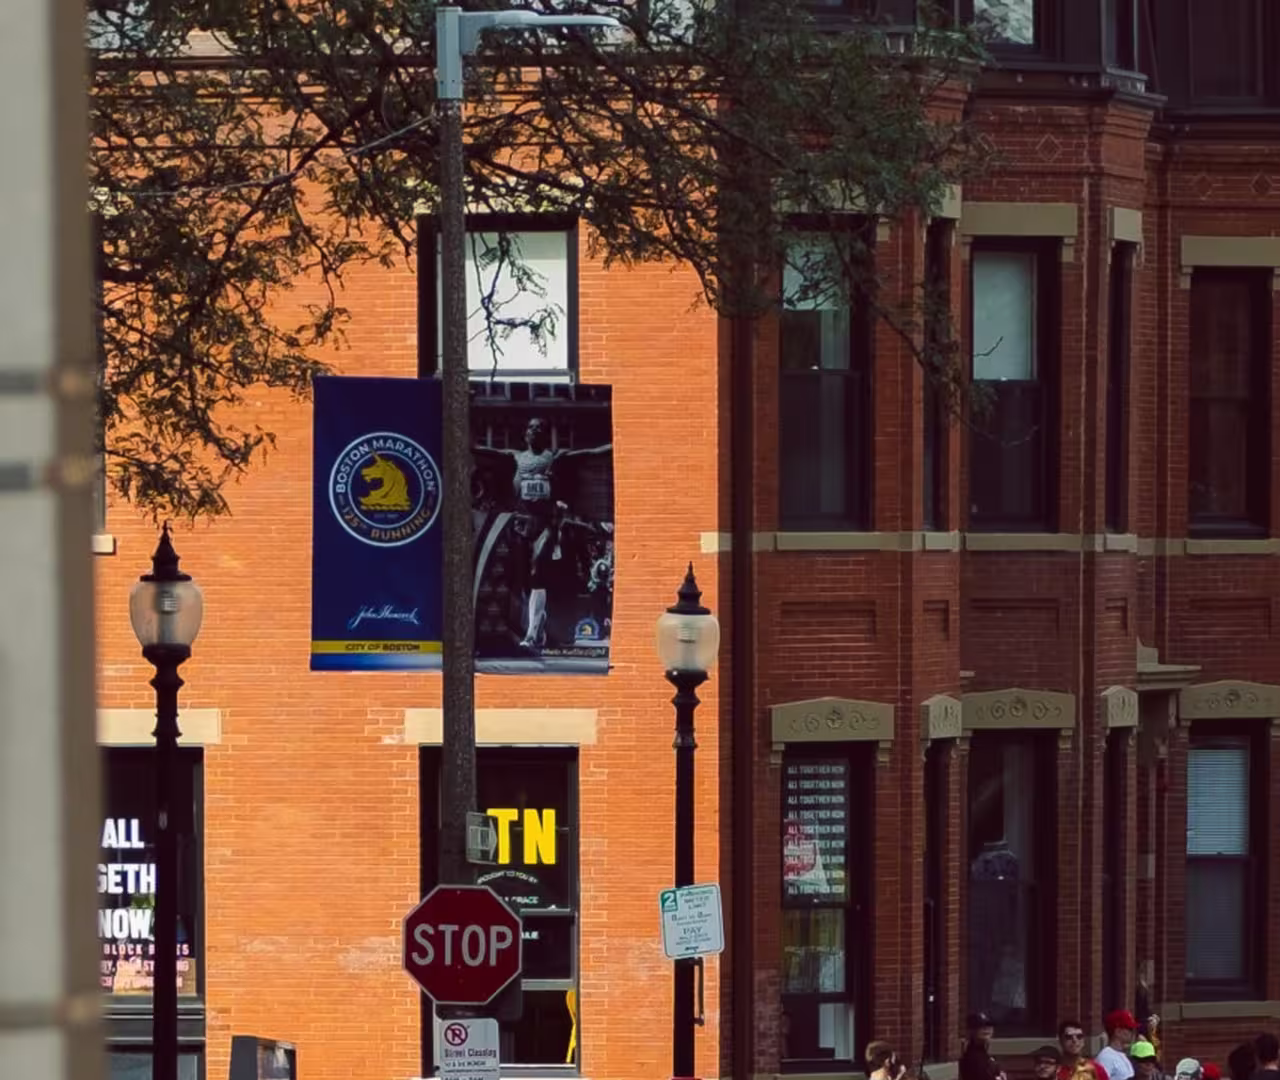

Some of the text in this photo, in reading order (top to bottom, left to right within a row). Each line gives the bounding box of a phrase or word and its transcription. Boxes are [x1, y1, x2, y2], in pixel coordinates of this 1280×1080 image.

[336, 439, 436, 493] BOSTON MARATHON
[371, 508, 430, 540] RUNNING
[382, 643, 420, 651] BOSTON
[102, 818, 145, 849] ALL
[663, 892, 676, 907] 2
[412, 923, 513, 966] STOP
